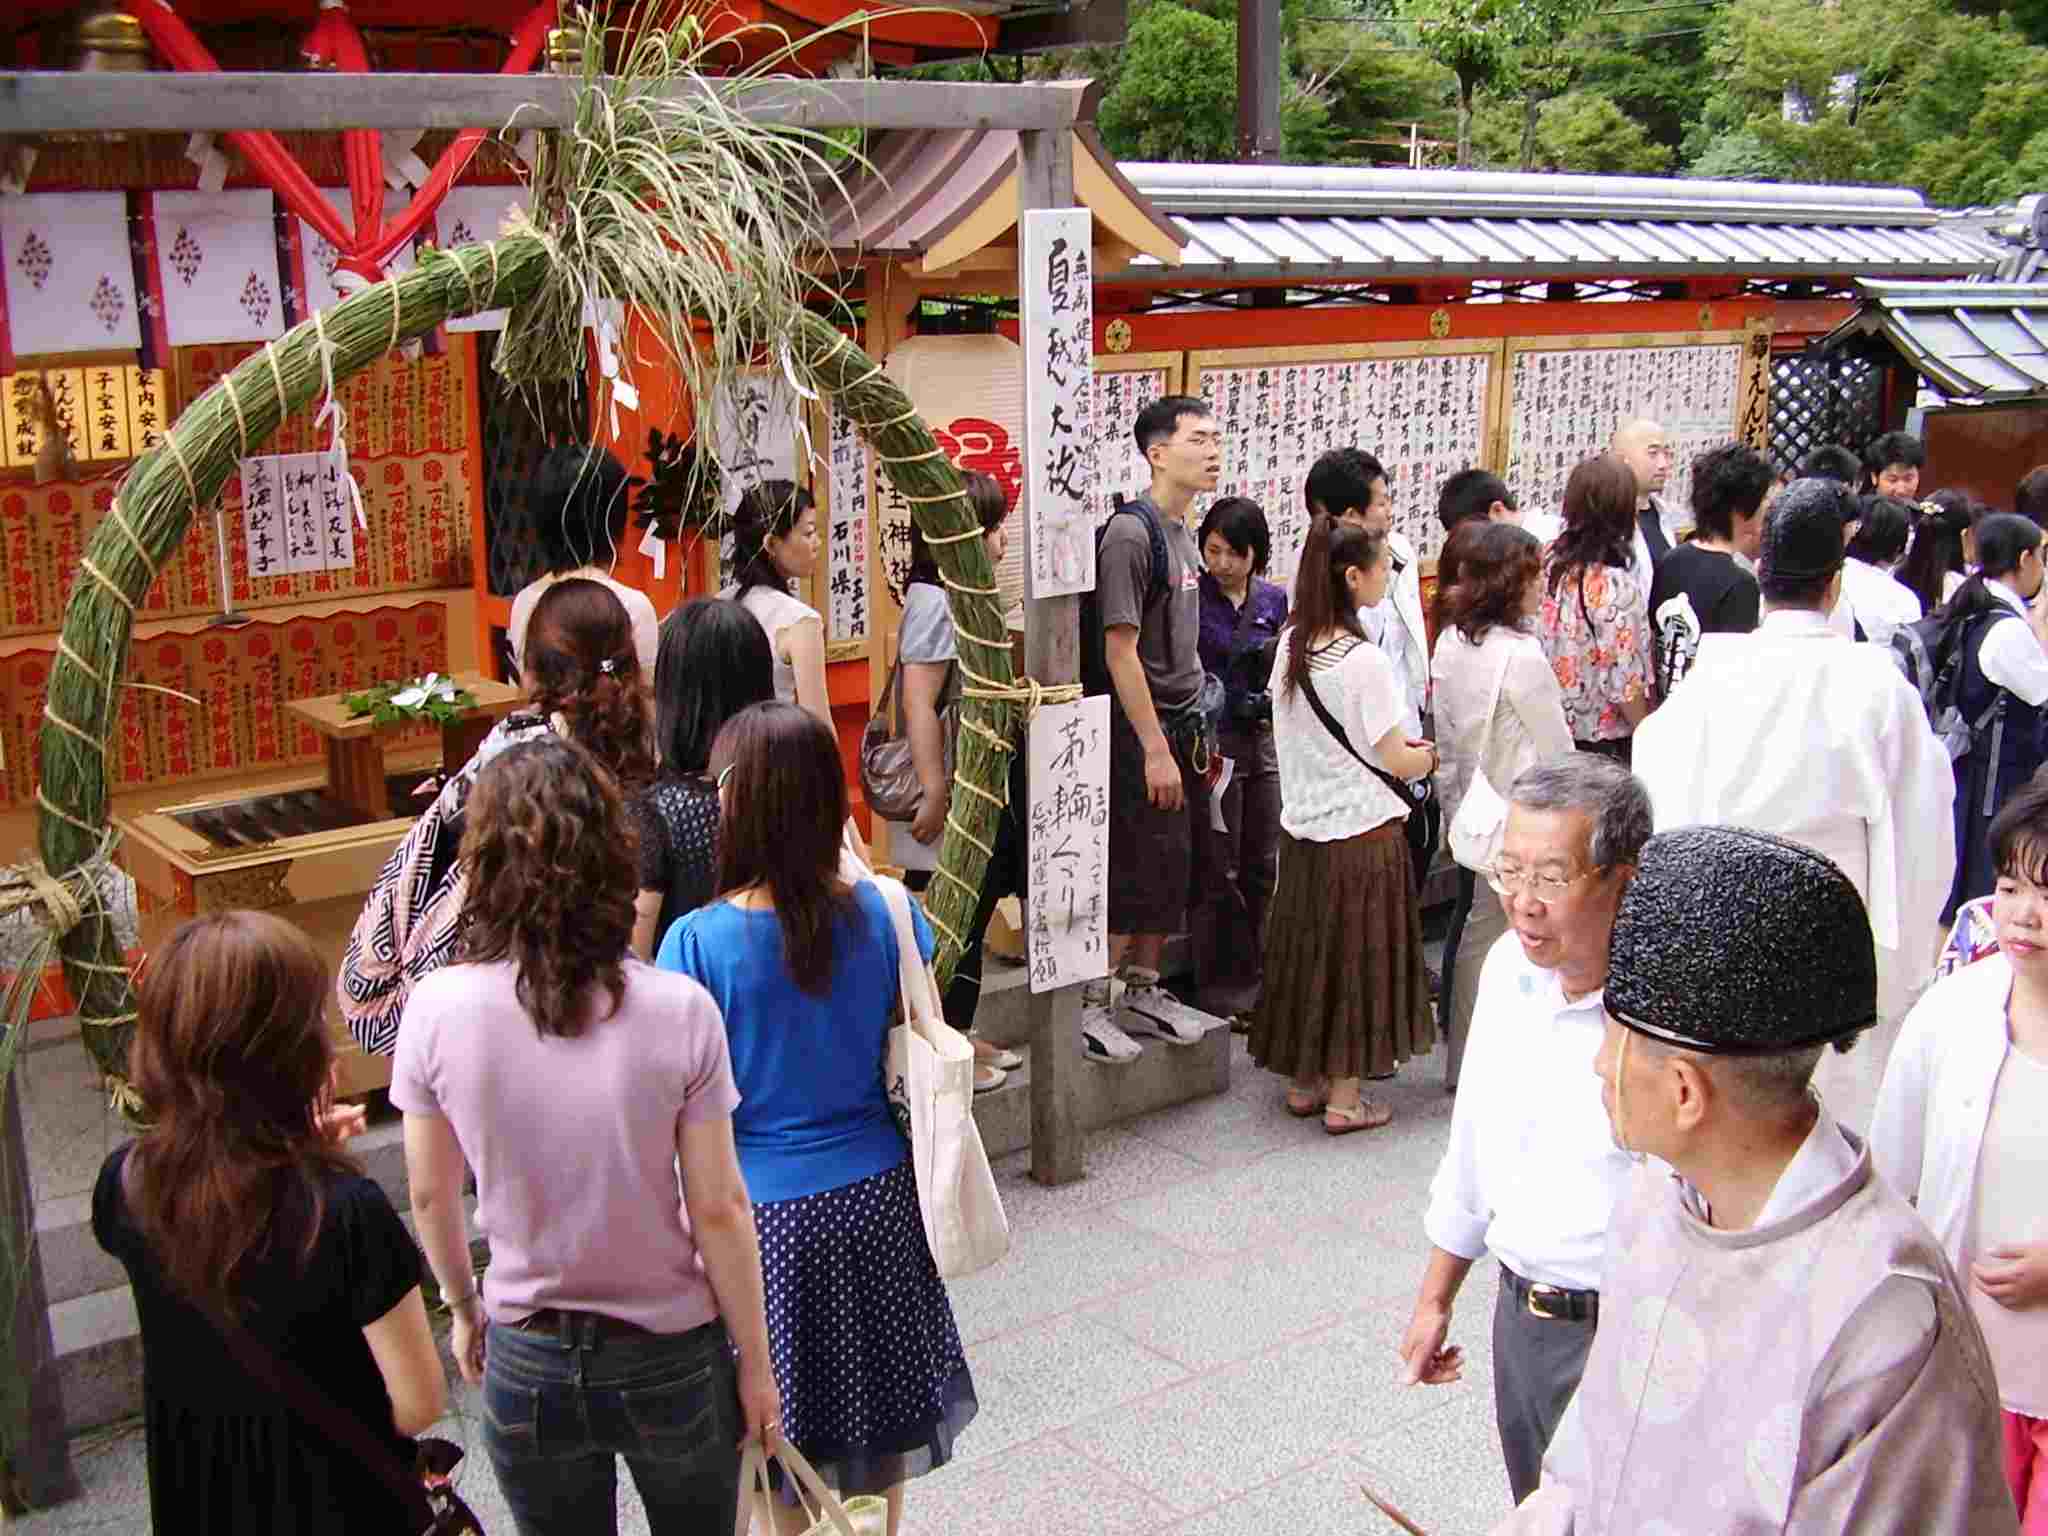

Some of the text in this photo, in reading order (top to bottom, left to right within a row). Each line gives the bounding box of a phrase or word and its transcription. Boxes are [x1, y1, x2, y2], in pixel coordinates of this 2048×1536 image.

[1103, 375, 1125, 442] 長崎県
[1363, 362, 1380, 418] スイス
[831, 521, 851, 594] 石川県
[851, 578, 865, 636] 五千円
